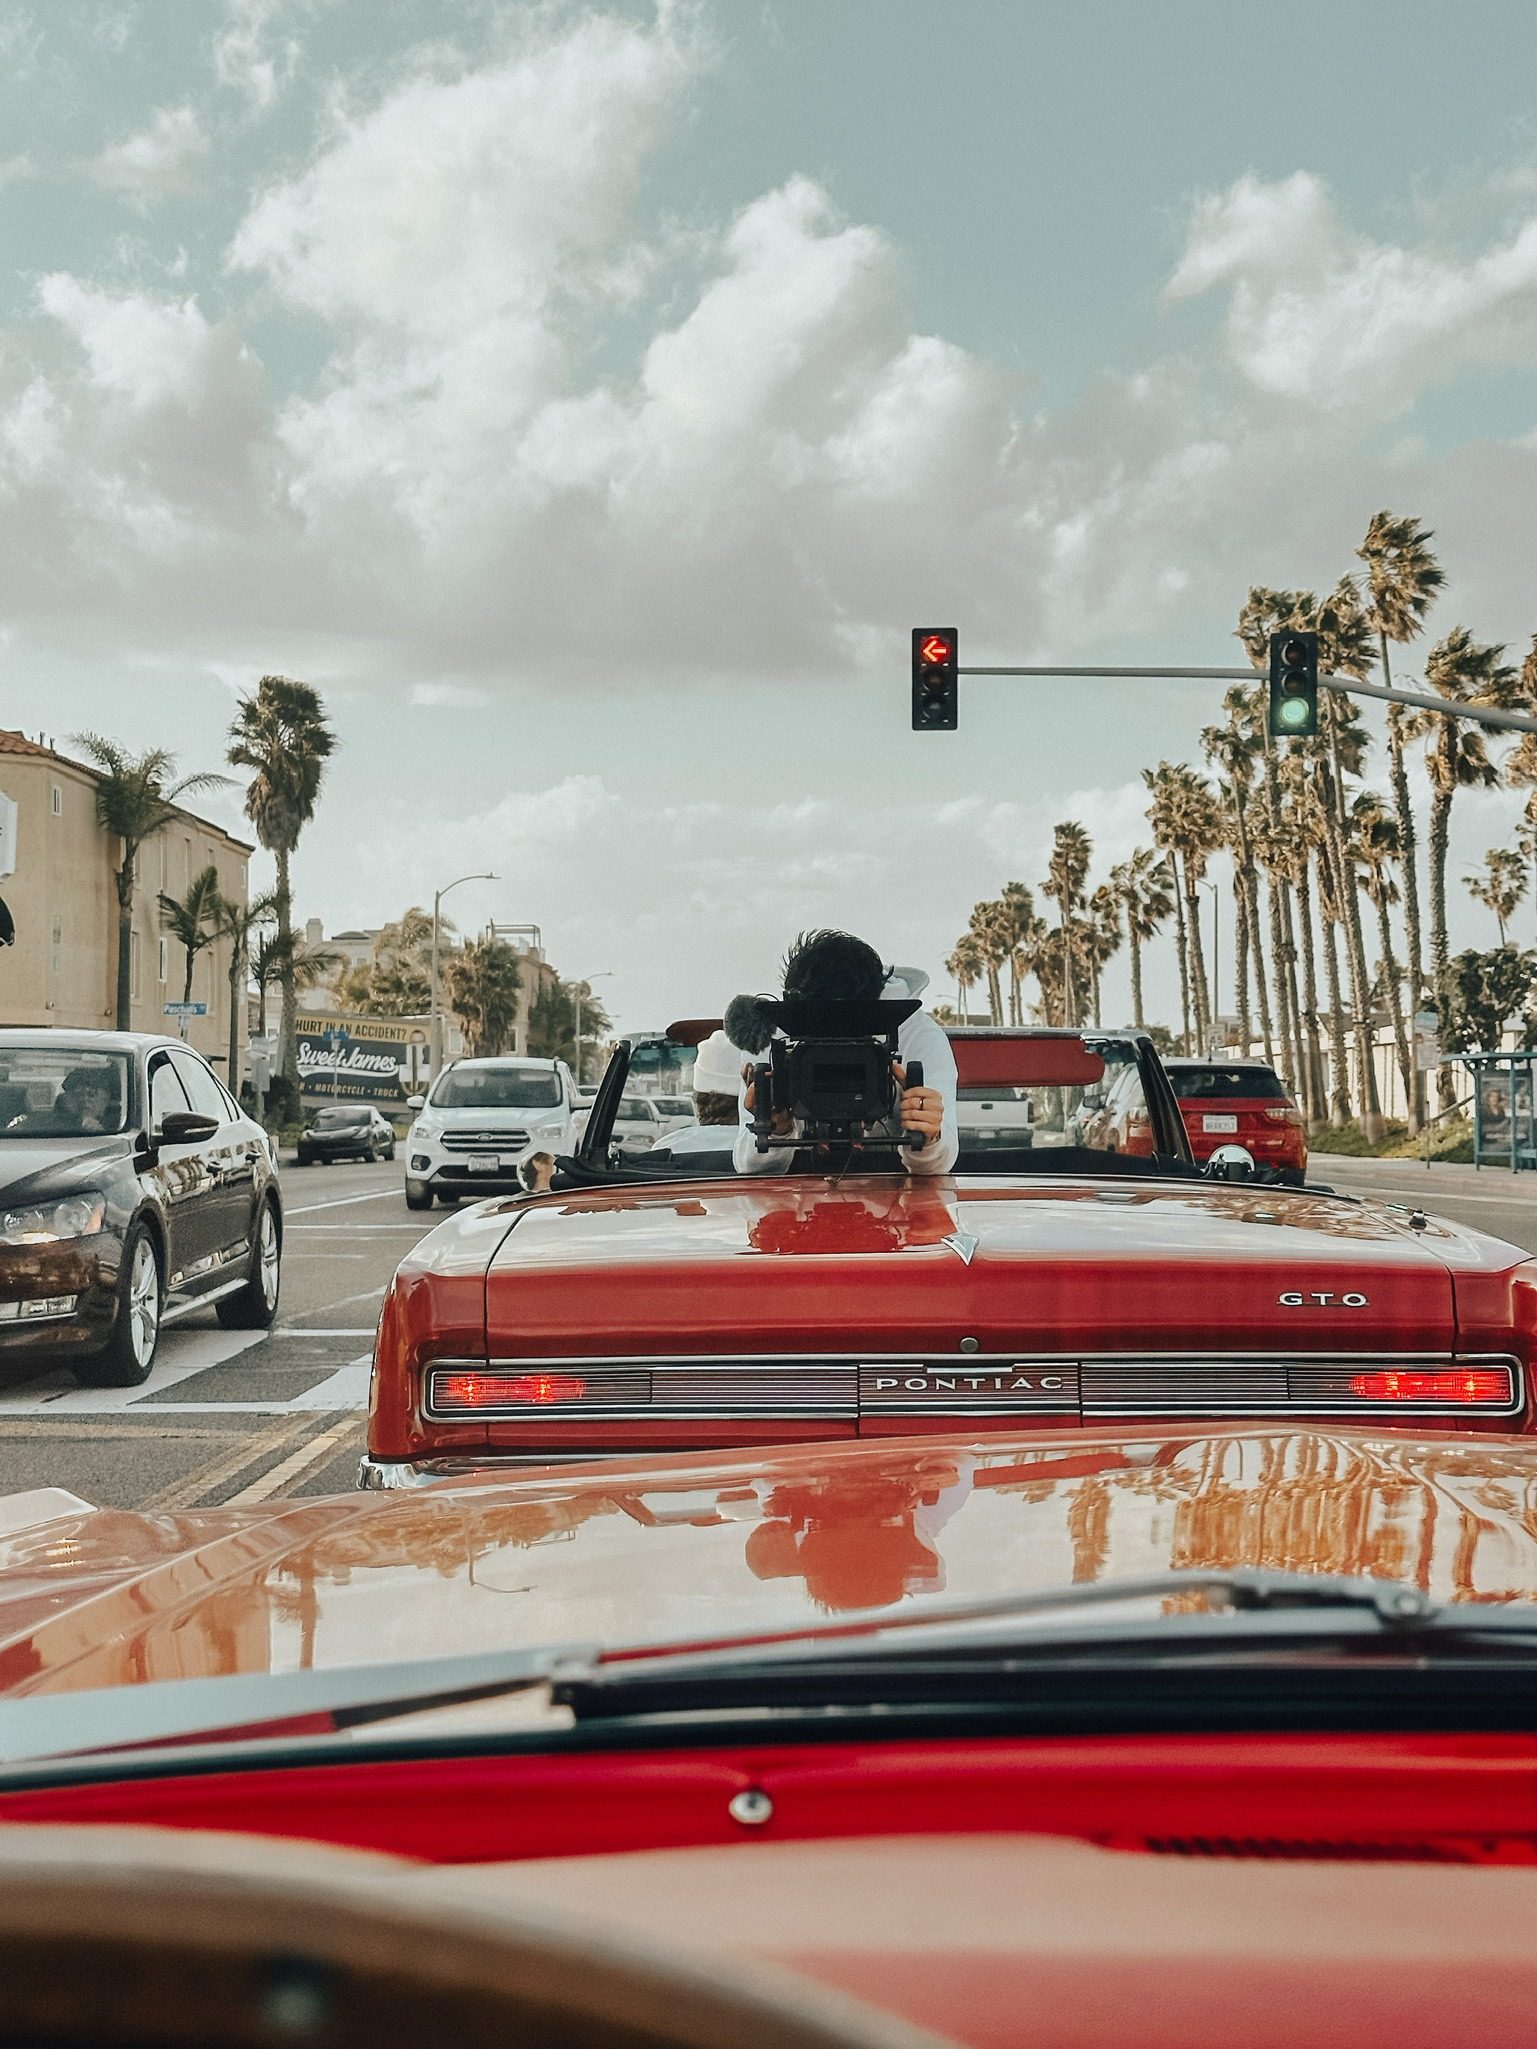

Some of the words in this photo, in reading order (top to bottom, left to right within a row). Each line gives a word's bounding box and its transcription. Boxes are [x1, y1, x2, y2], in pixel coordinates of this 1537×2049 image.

[296, 1019, 322, 1033] HURT
[325, 1021, 337, 1032] IN
[339, 1023, 352, 1036] AN
[354, 1024, 408, 1041] ACCIDENT?
[296, 1041, 346, 1068] Sweet
[345, 1046, 397, 1072] James
[315, 1082, 366, 1096] MOTORCYCLE
[373, 1087, 399, 1098] TRUCK
[1279, 1292, 1368, 1307] GTO
[876, 1376, 1063, 1391] PONTIAC
